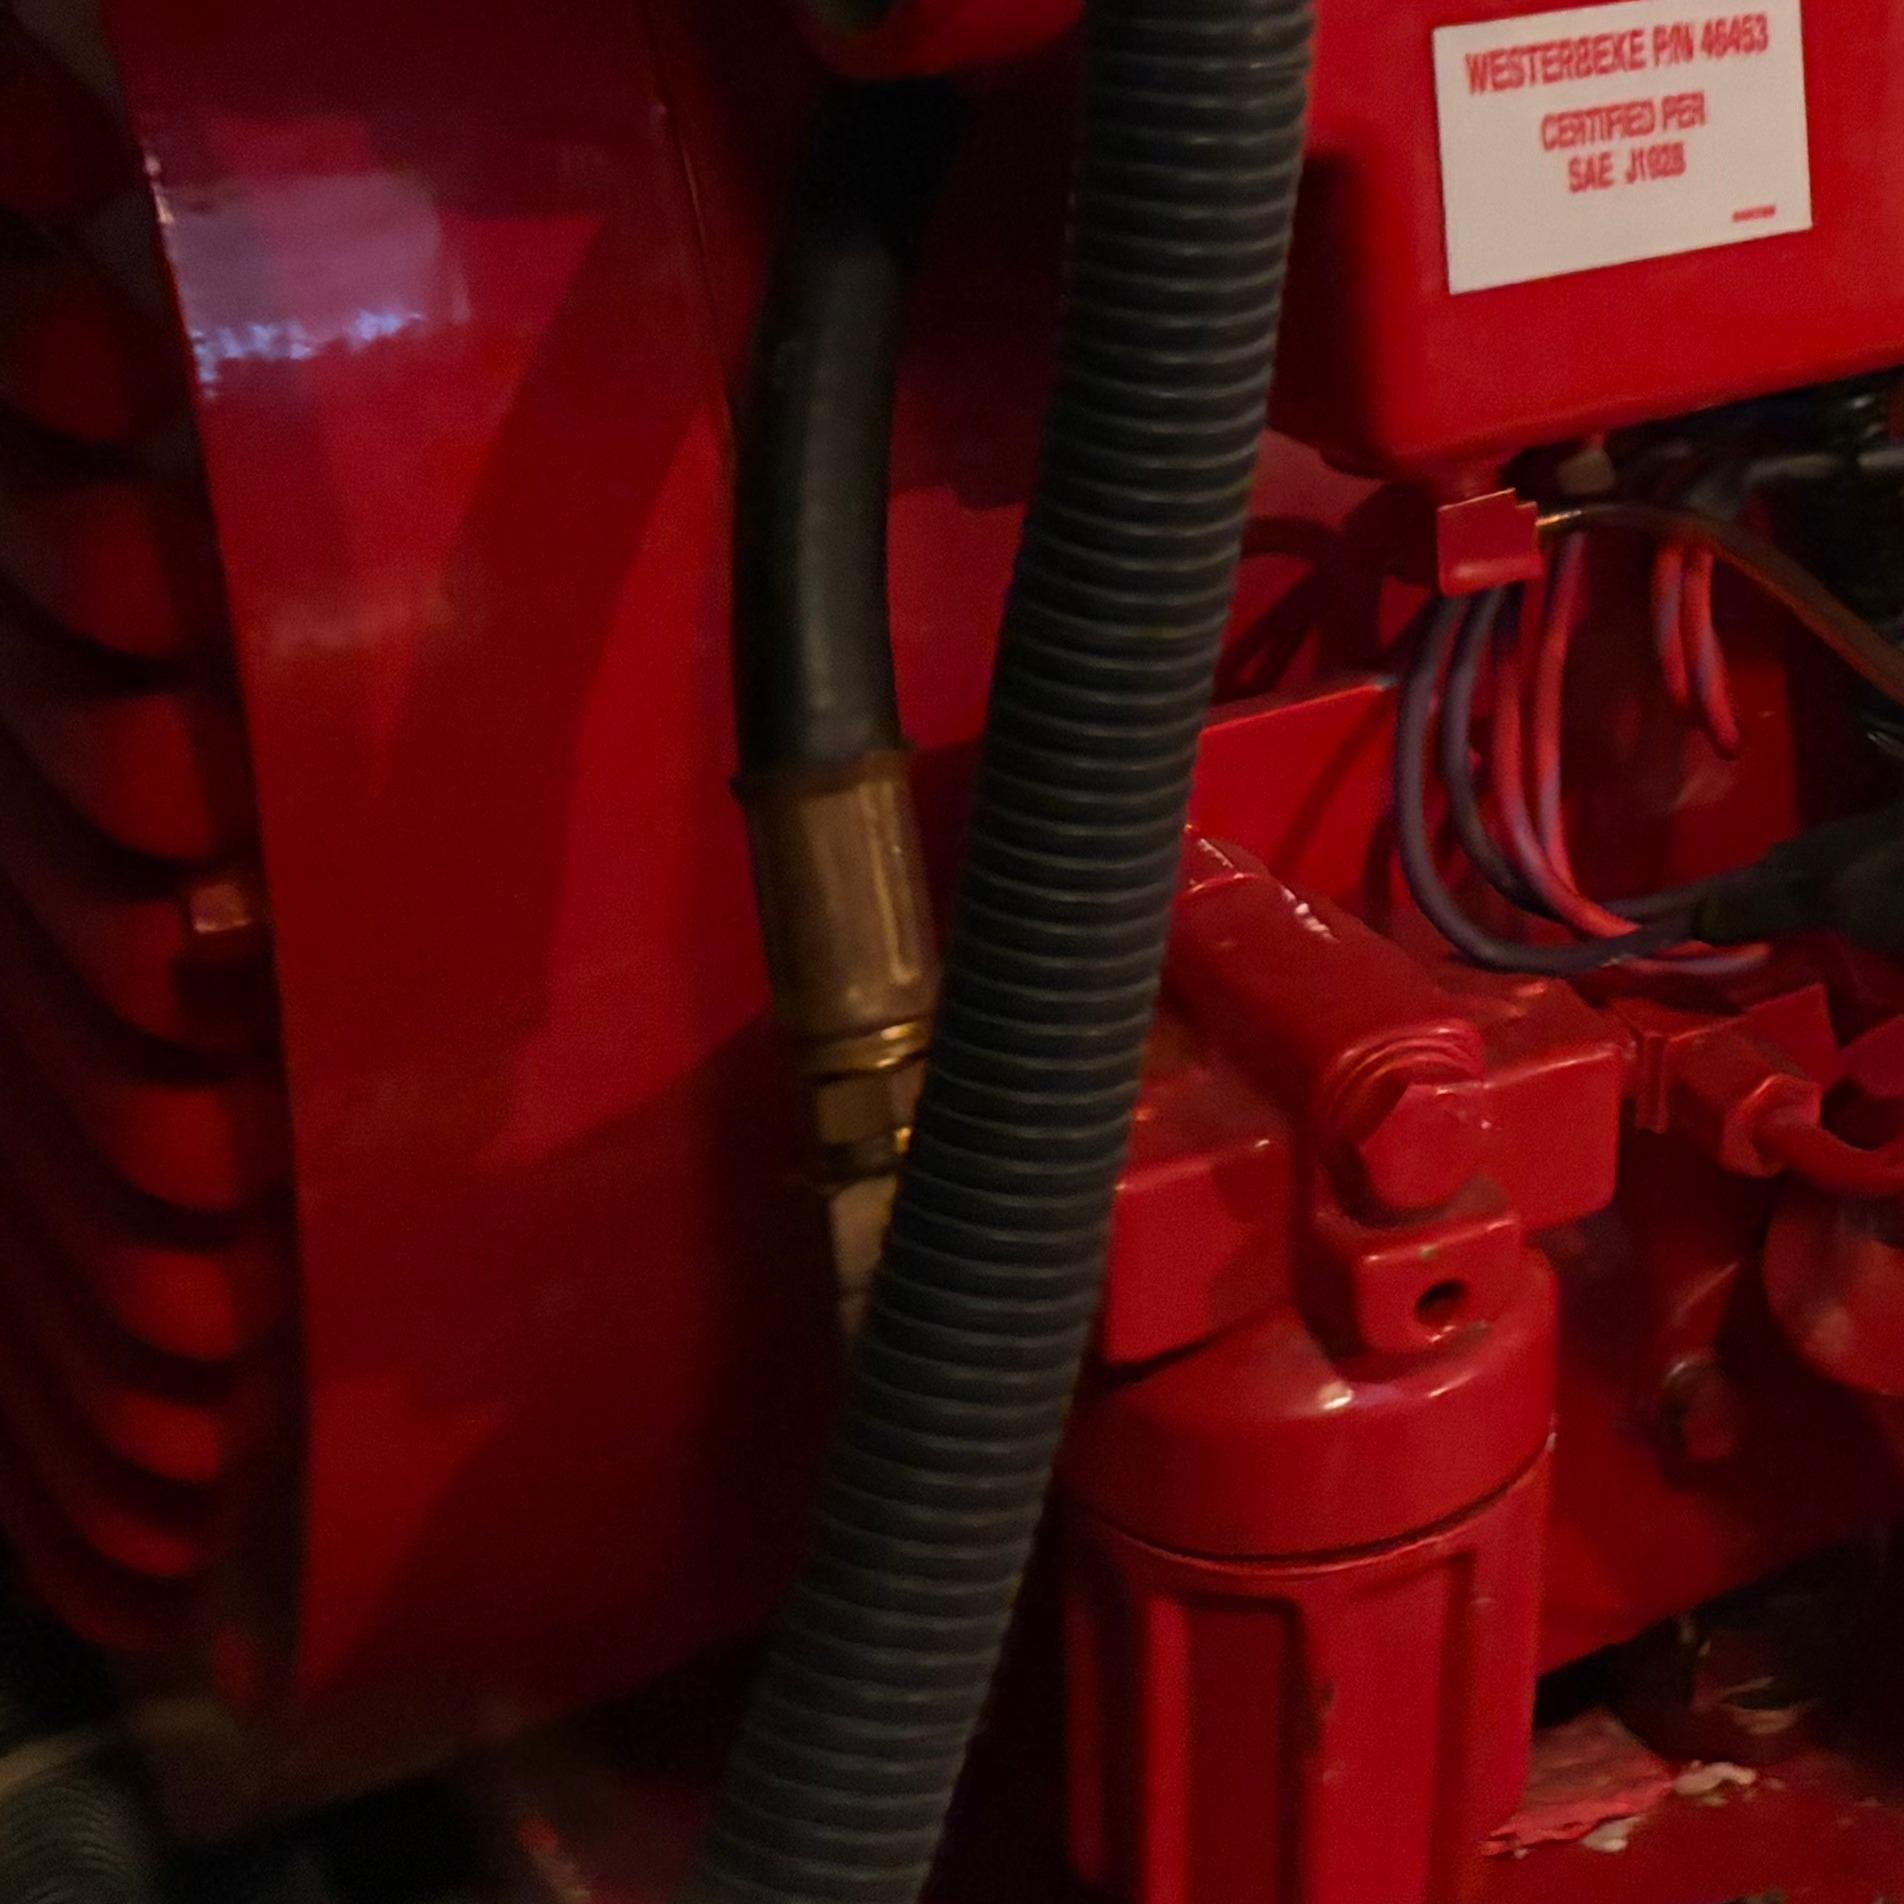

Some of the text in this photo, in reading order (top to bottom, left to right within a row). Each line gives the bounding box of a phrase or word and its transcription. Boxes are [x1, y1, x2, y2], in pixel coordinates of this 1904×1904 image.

[1463, 29, 1648, 96] WESTERBEKE
[1540, 91, 1707, 151] CERTIFIED PER
[1567, 151, 1614, 193] SAE
